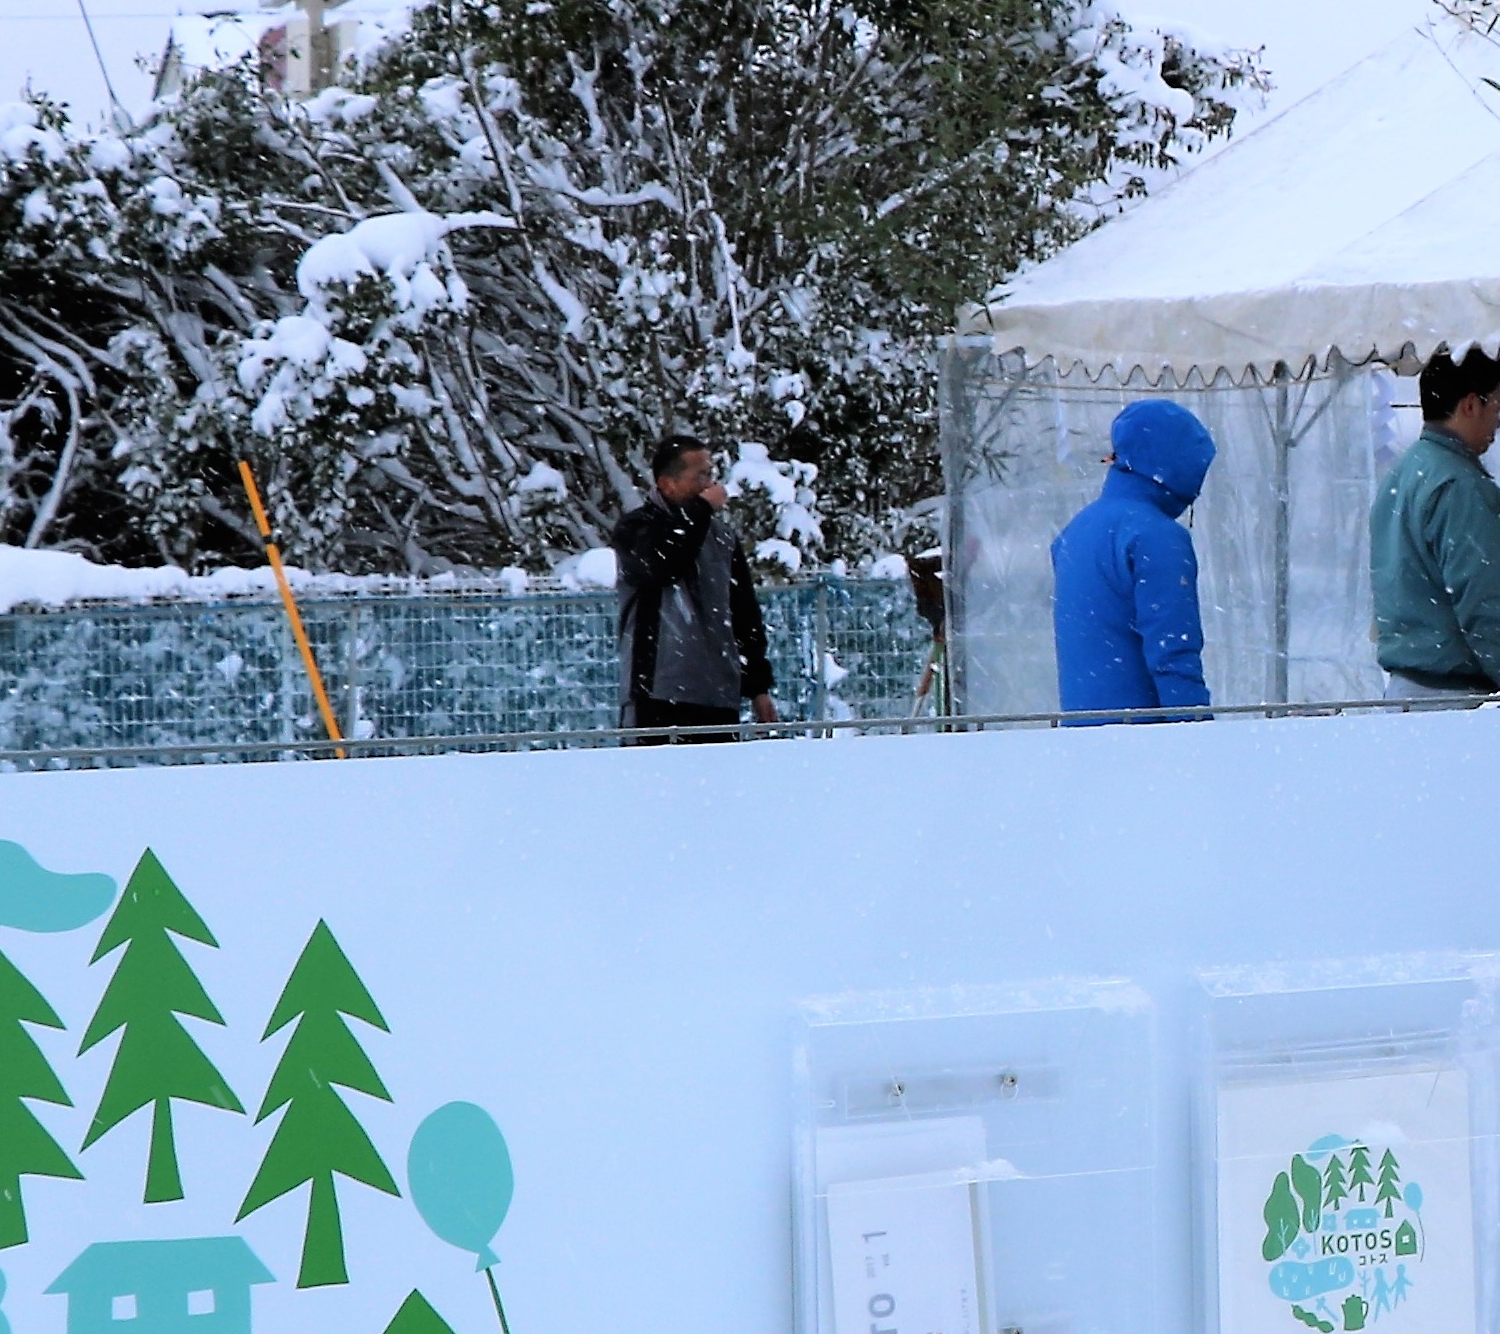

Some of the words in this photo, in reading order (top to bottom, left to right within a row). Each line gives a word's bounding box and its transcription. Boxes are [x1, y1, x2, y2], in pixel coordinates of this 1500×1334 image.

[1321, 1229, 1392, 1256] KOTOS
[1359, 1252, 1388, 1266] コトス
